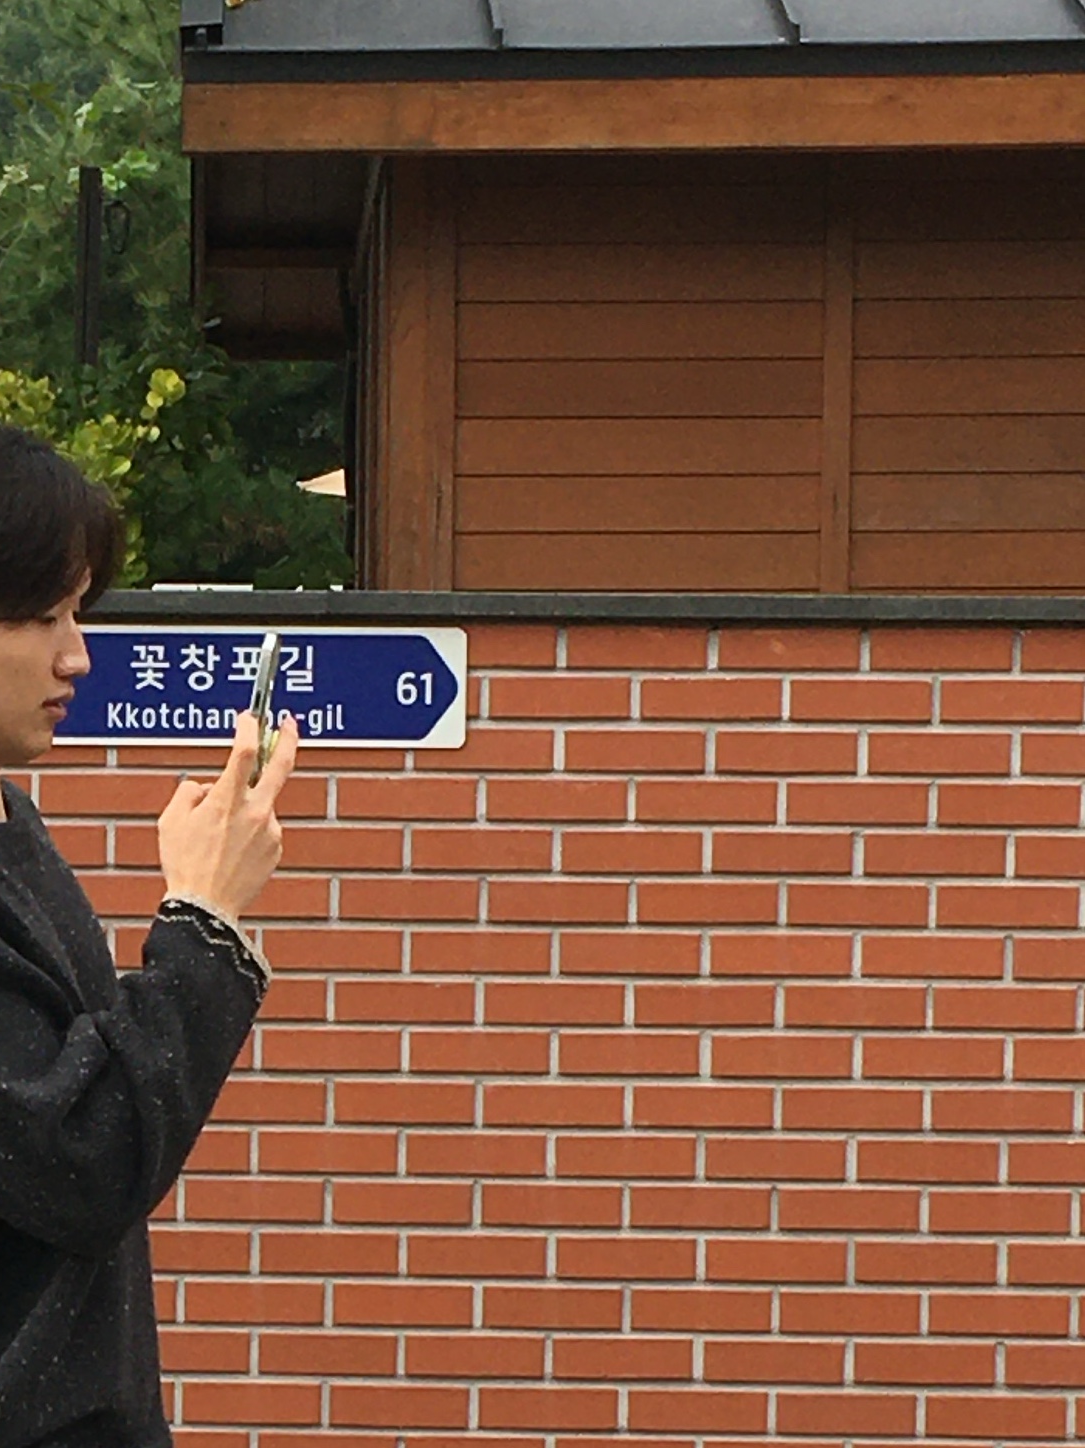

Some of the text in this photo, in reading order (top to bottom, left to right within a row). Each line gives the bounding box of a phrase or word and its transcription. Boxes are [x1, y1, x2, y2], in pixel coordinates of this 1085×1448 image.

[130, 644, 314, 692] 꽃창포길
[396, 671, 434, 705] 61
[107, 702, 345, 736] Kkotchano-gil
